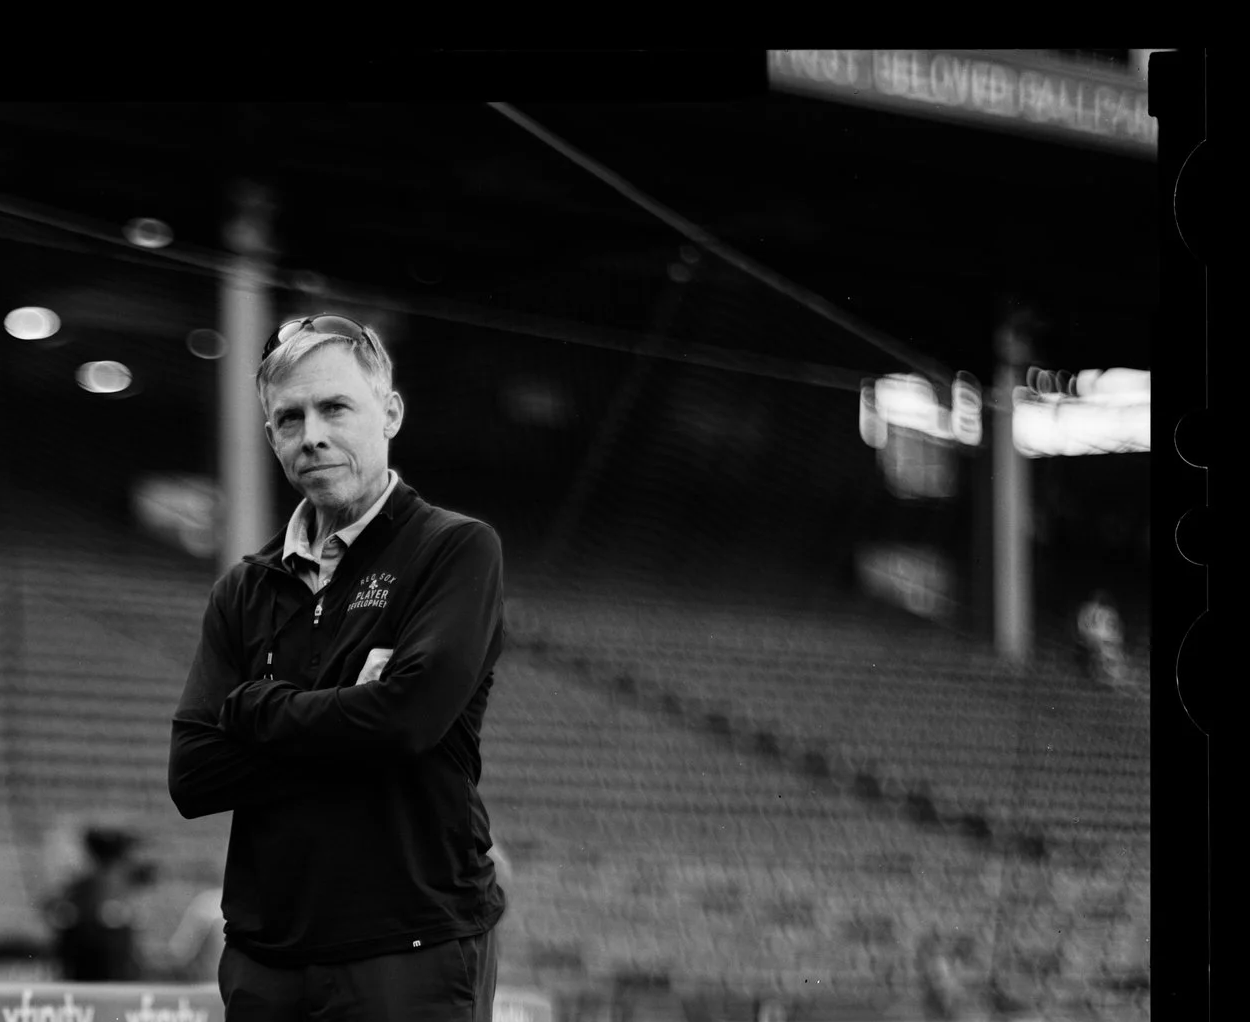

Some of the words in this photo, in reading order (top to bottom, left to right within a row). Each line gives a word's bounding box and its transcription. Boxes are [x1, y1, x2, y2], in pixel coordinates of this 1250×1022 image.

[360, 573, 376, 583] RED
[379, 572, 396, 584] SOX
[355, 589, 389, 601] PLAYER
